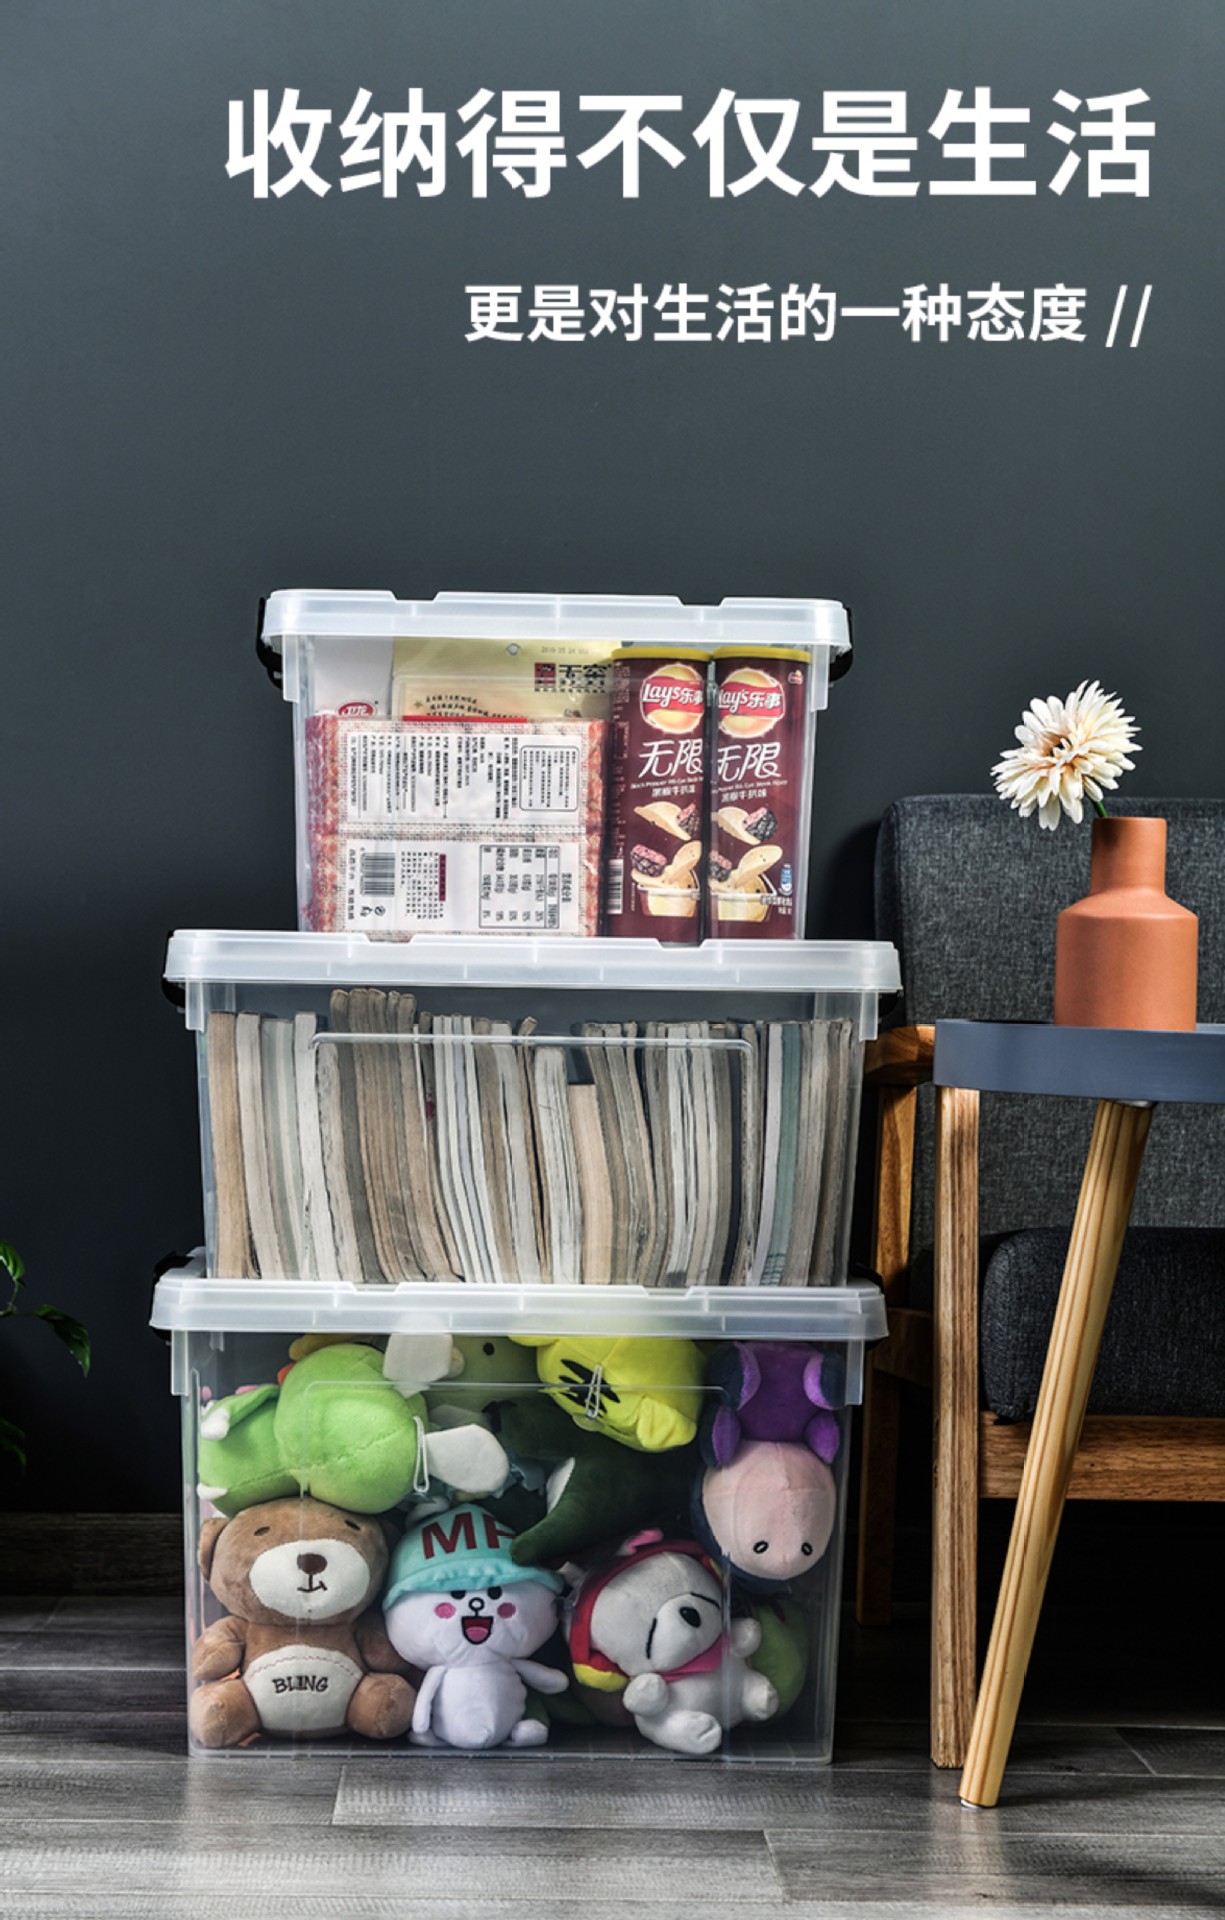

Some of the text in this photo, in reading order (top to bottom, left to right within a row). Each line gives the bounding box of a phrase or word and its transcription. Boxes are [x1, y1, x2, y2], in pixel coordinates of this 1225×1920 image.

[638, 738, 703, 778] 无限
[717, 742, 782, 782] 无限
[272, 1675, 328, 1693] BLING
